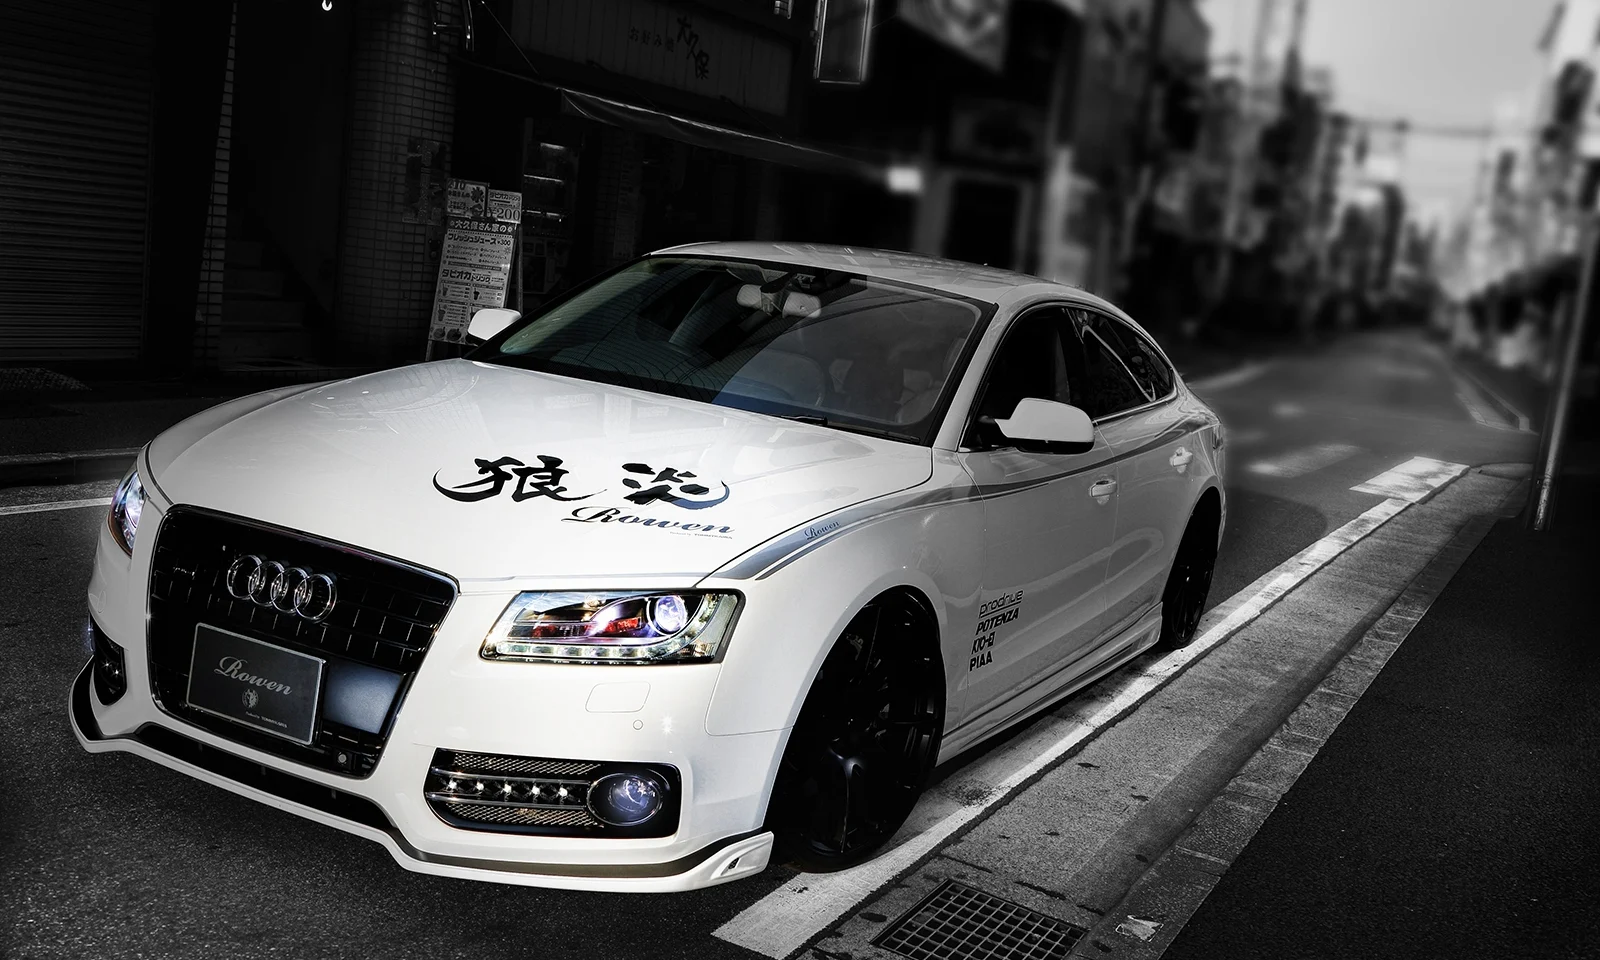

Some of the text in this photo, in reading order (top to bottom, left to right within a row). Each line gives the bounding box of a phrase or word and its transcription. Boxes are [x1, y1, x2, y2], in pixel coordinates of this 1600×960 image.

[561, 505, 735, 534] Rowen
[803, 521, 840, 541] Rowen
[976, 607, 1019, 635] POTENZA
[969, 650, 993, 671] PIAA
[213, 656, 292, 696] Rowen
